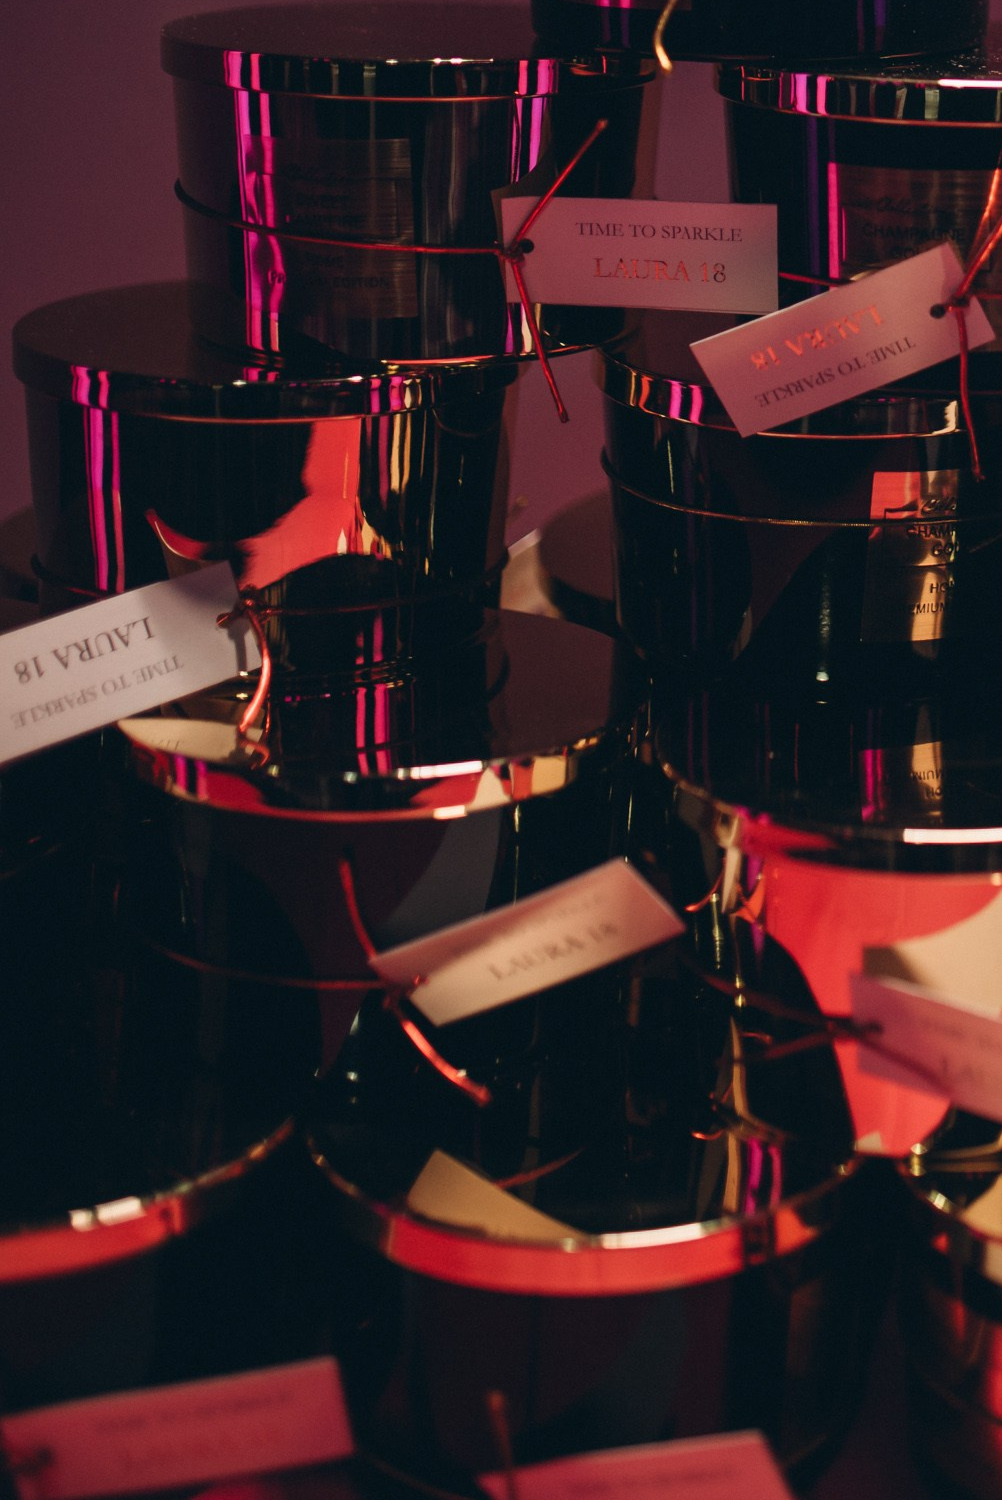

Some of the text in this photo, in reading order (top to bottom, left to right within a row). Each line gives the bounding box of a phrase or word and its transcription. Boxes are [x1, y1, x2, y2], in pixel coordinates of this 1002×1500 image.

[575, 222, 743, 242] TIME TO SPARKLE
[592, 257, 727, 283] LAURA 18
[749, 303, 884, 371] LAURA 18
[754, 336, 917, 408] TIME TO SPARKLE
[13, 615, 156, 685] LAURA 18
[9, 654, 185, 731] TIME TO SPARKLE
